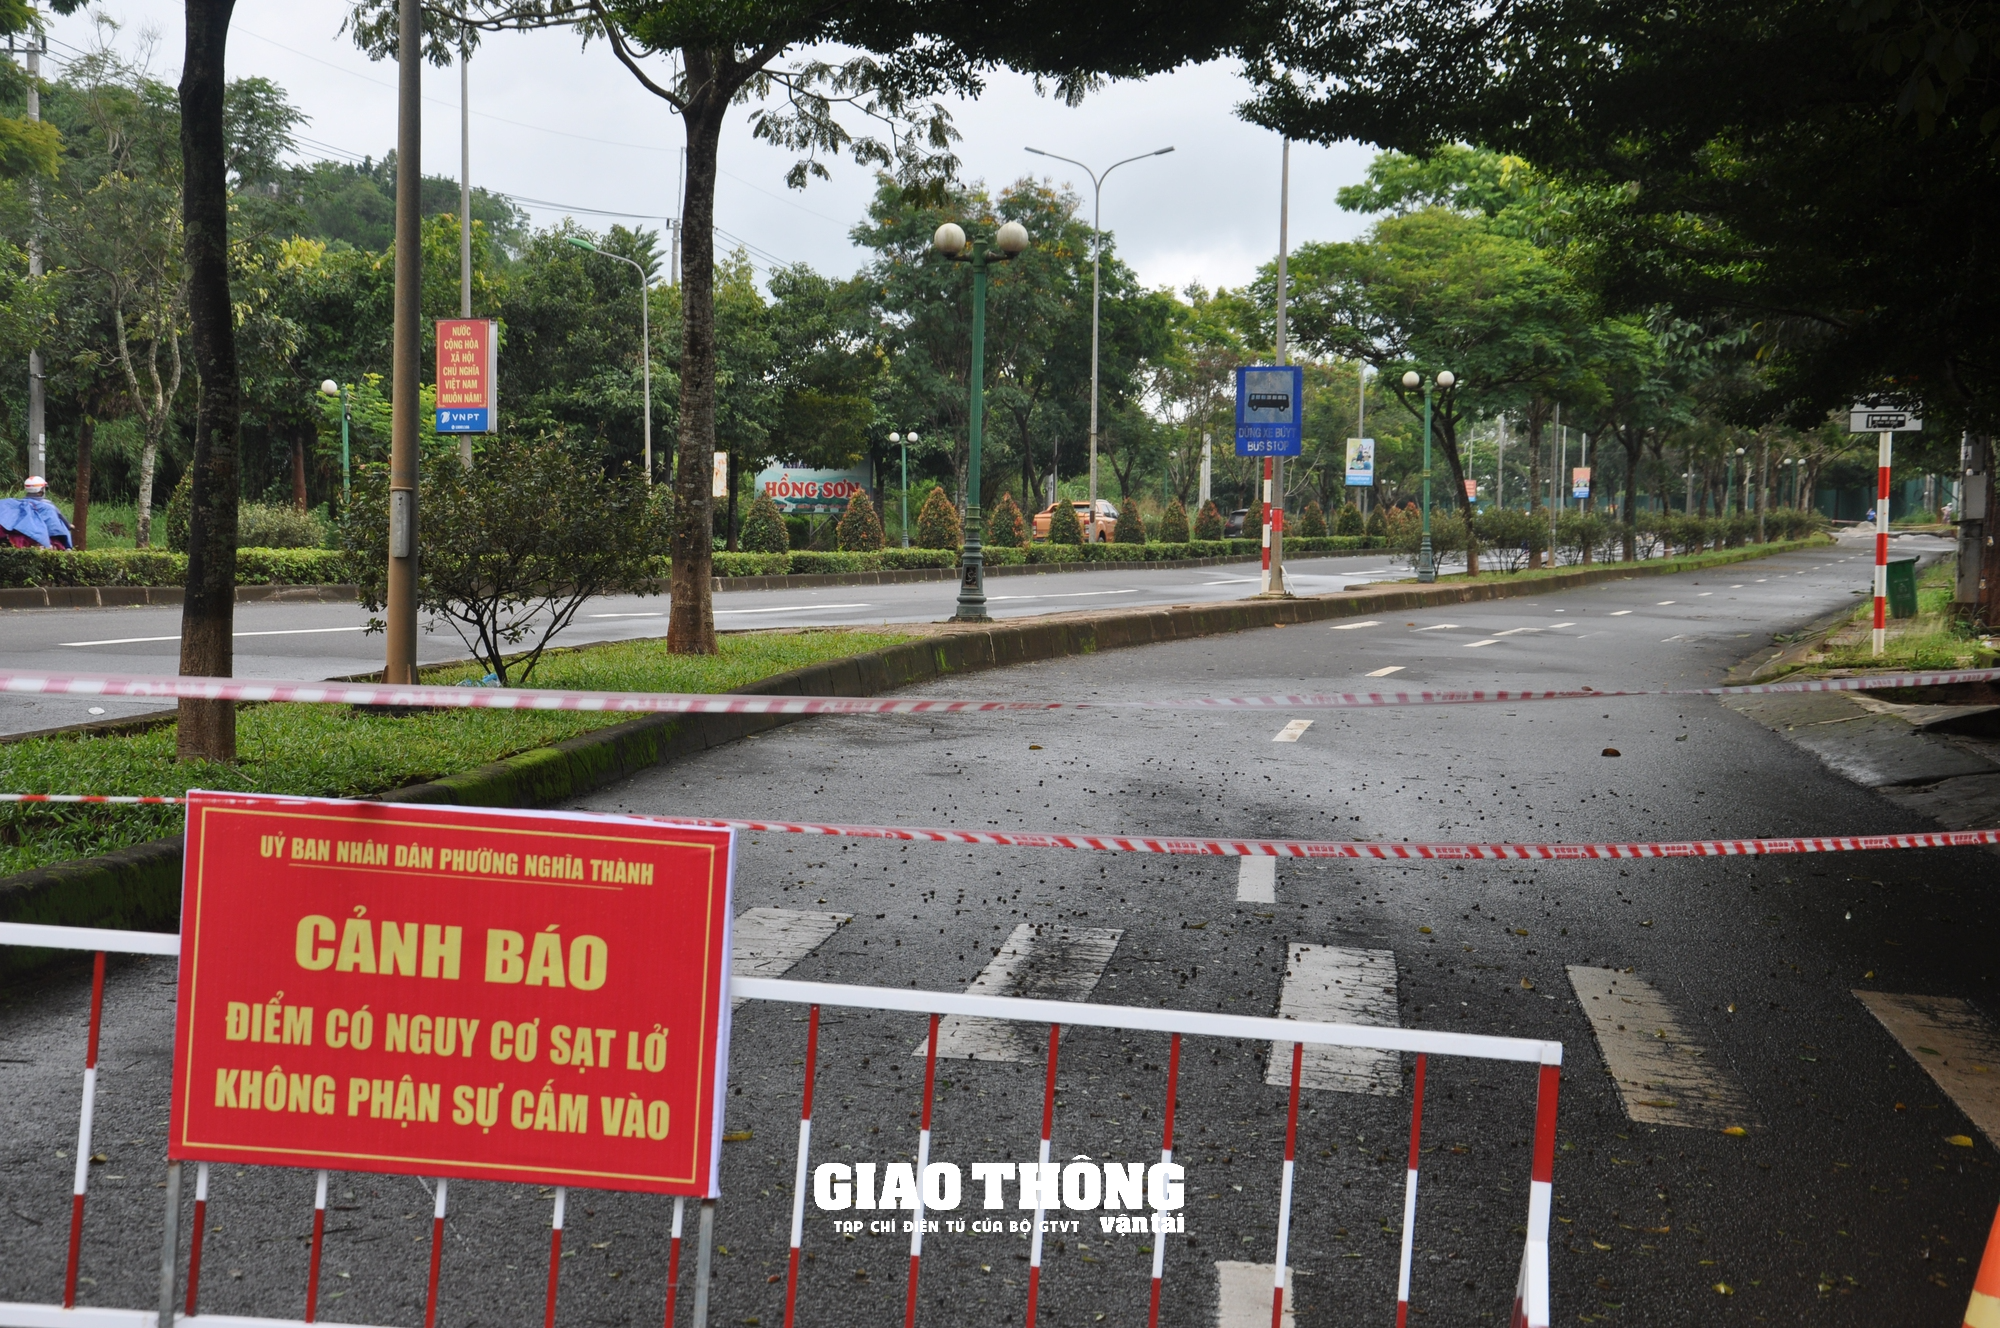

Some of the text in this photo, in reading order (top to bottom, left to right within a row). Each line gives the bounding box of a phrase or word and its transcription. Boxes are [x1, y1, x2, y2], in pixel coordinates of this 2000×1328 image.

[452, 324, 471, 336] NƯỚC
[444, 338, 479, 351] CỘNG HÒA
[451, 351, 475, 364] XÃ HỘI
[443, 363, 480, 376] CHỦ NGHĨA
[445, 377, 478, 390] VIỆT NAM
[442, 391, 482, 403] MUÔN NĂM!
[452, 413, 480, 421] VNPT
[1263, 427, 1274, 438] XE
[1247, 440, 1290, 452] BUS STOP
[765, 473, 860, 498] HỒNG SƠN
[291, 837, 330, 861] BAN
[336, 839, 388, 865] NHÂN
[394, 842, 433, 869] DÂN
[439, 847, 518, 875] PHƯỜNG
[524, 854, 584, 880] NGHĨA
[590, 858, 654, 885] THÀNH
[295, 905, 608, 991] CẢNH BÁO
[225, 990, 669, 1074] ĐIỂM CÓ NGUY CƠ SẠT LỞ
[215, 1064, 670, 1141] KHÔNG PHẬN SỰ CẤM VÀO
